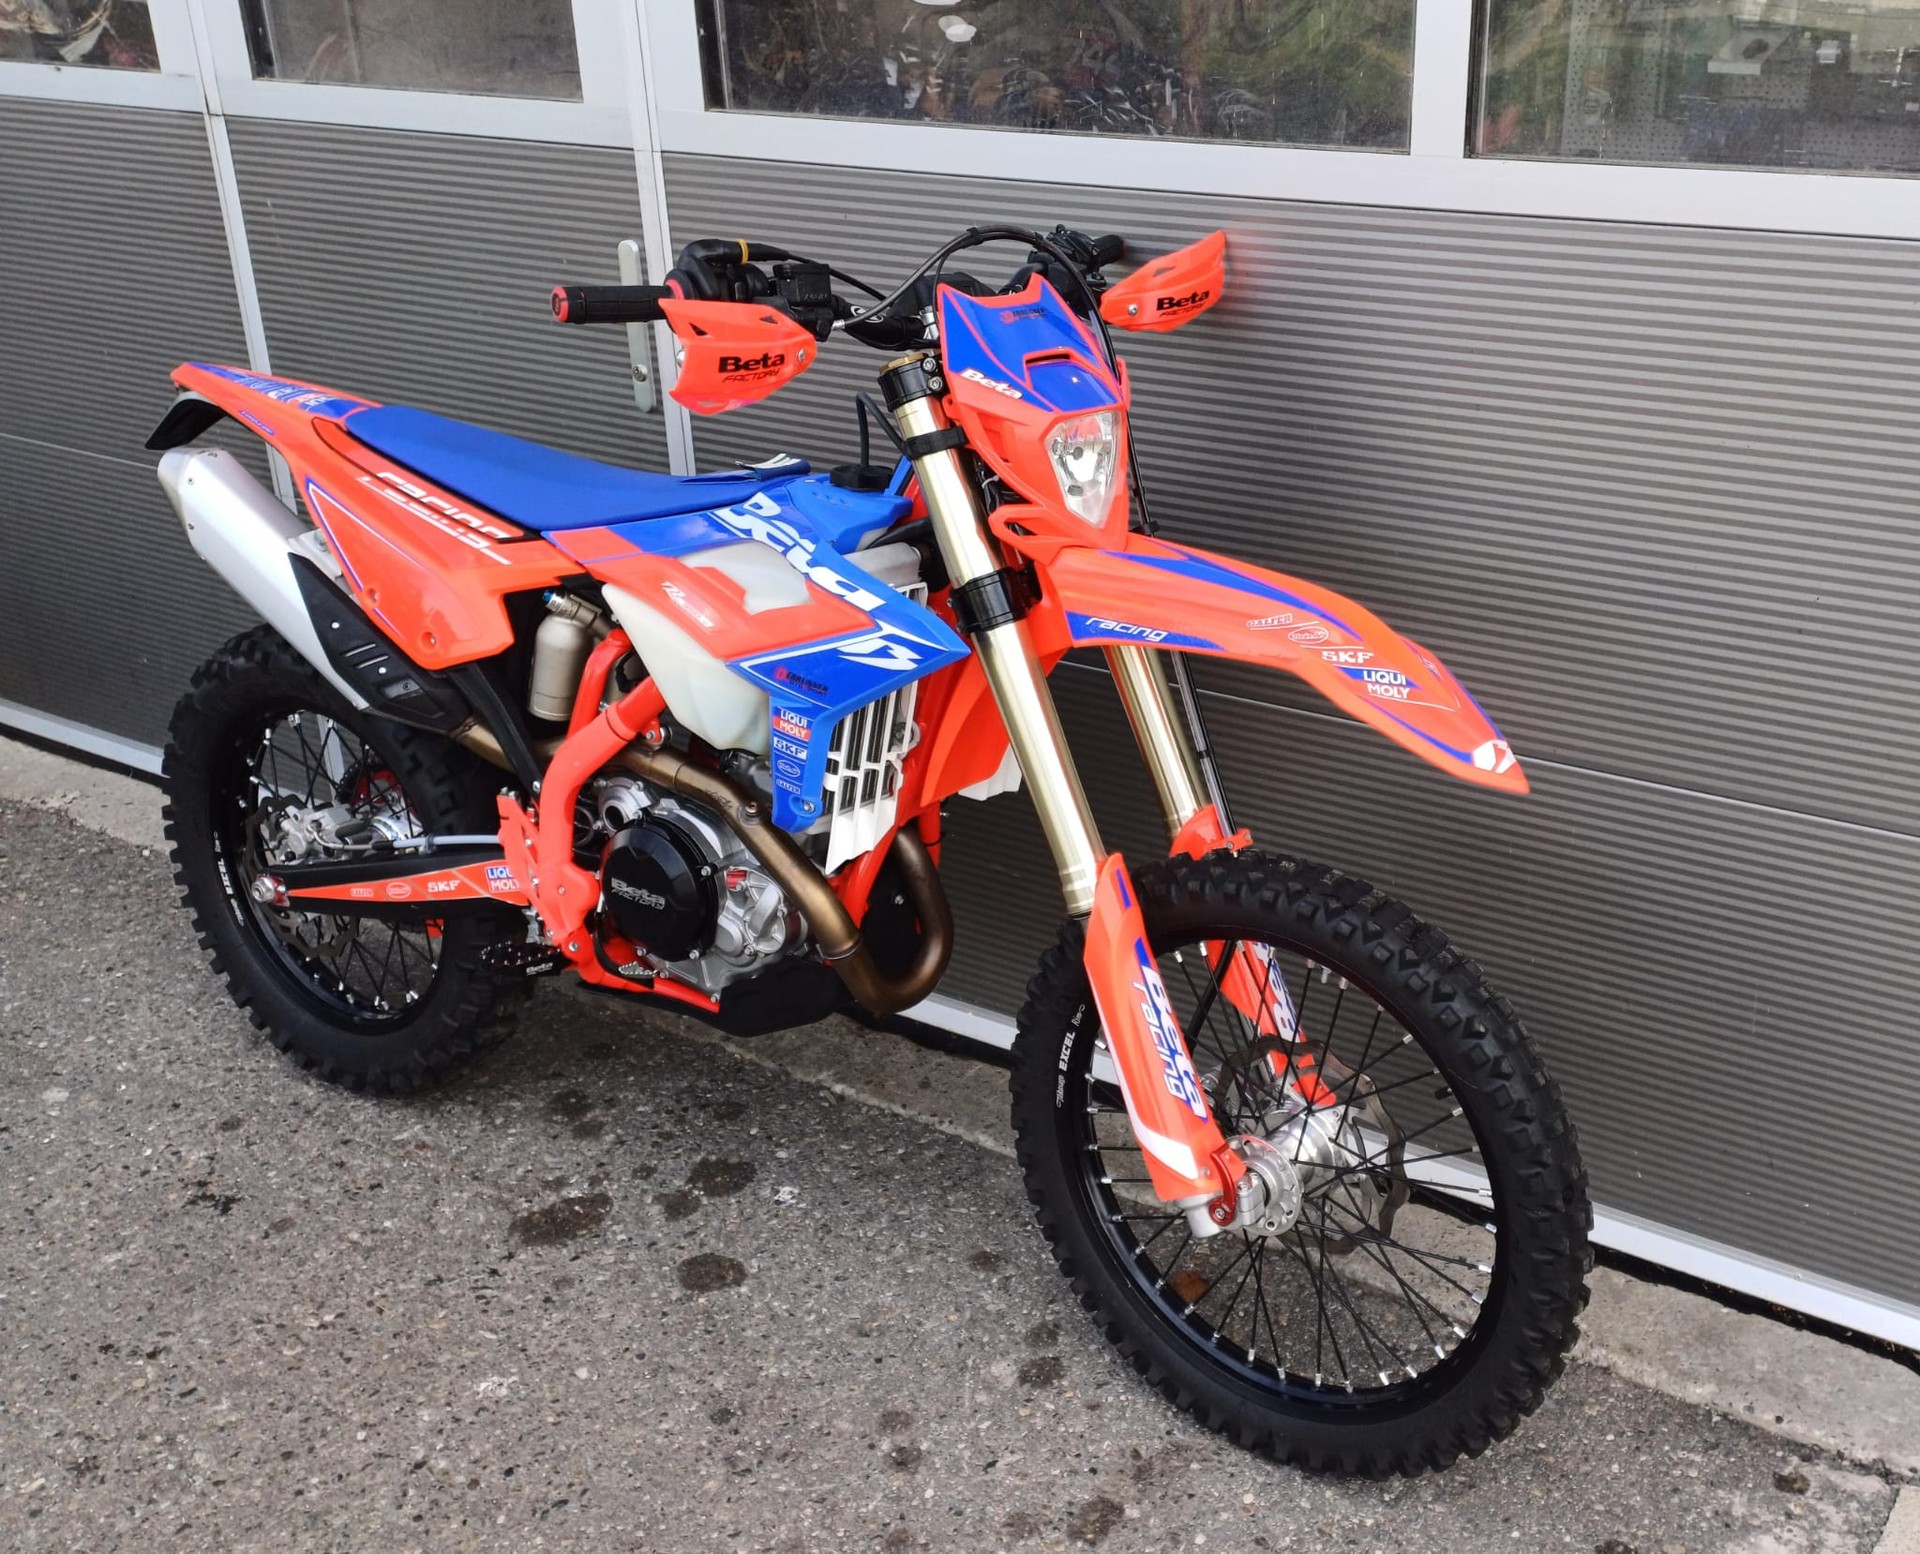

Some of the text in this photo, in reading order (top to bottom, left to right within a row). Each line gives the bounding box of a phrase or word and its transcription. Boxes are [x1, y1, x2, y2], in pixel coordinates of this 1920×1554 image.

[1156, 291, 1210, 311] Beta
[718, 352, 785, 373] Beta
[722, 368, 780, 383] FACTORY
[960, 368, 1023, 399] Beta
[714, 492, 886, 612] Beta
[1085, 617, 1169, 643] racing
[1322, 651, 1375, 664] SKF
[1363, 670, 1407, 686] LIQUI
[1367, 683, 1411, 700] MOLY
[781, 708, 808, 728] LIQUI
[779, 719, 807, 739] MOLY
[775, 739, 805, 756] SKF
[427, 879, 461, 893] SKF
[611, 877, 666, 905] Beta
[611, 888, 665, 911] FACTORY
[1059, 1031, 1076, 1072] EXCEL
[1133, 982, 1188, 1101] racing
[1142, 965, 1207, 1119] Beta
